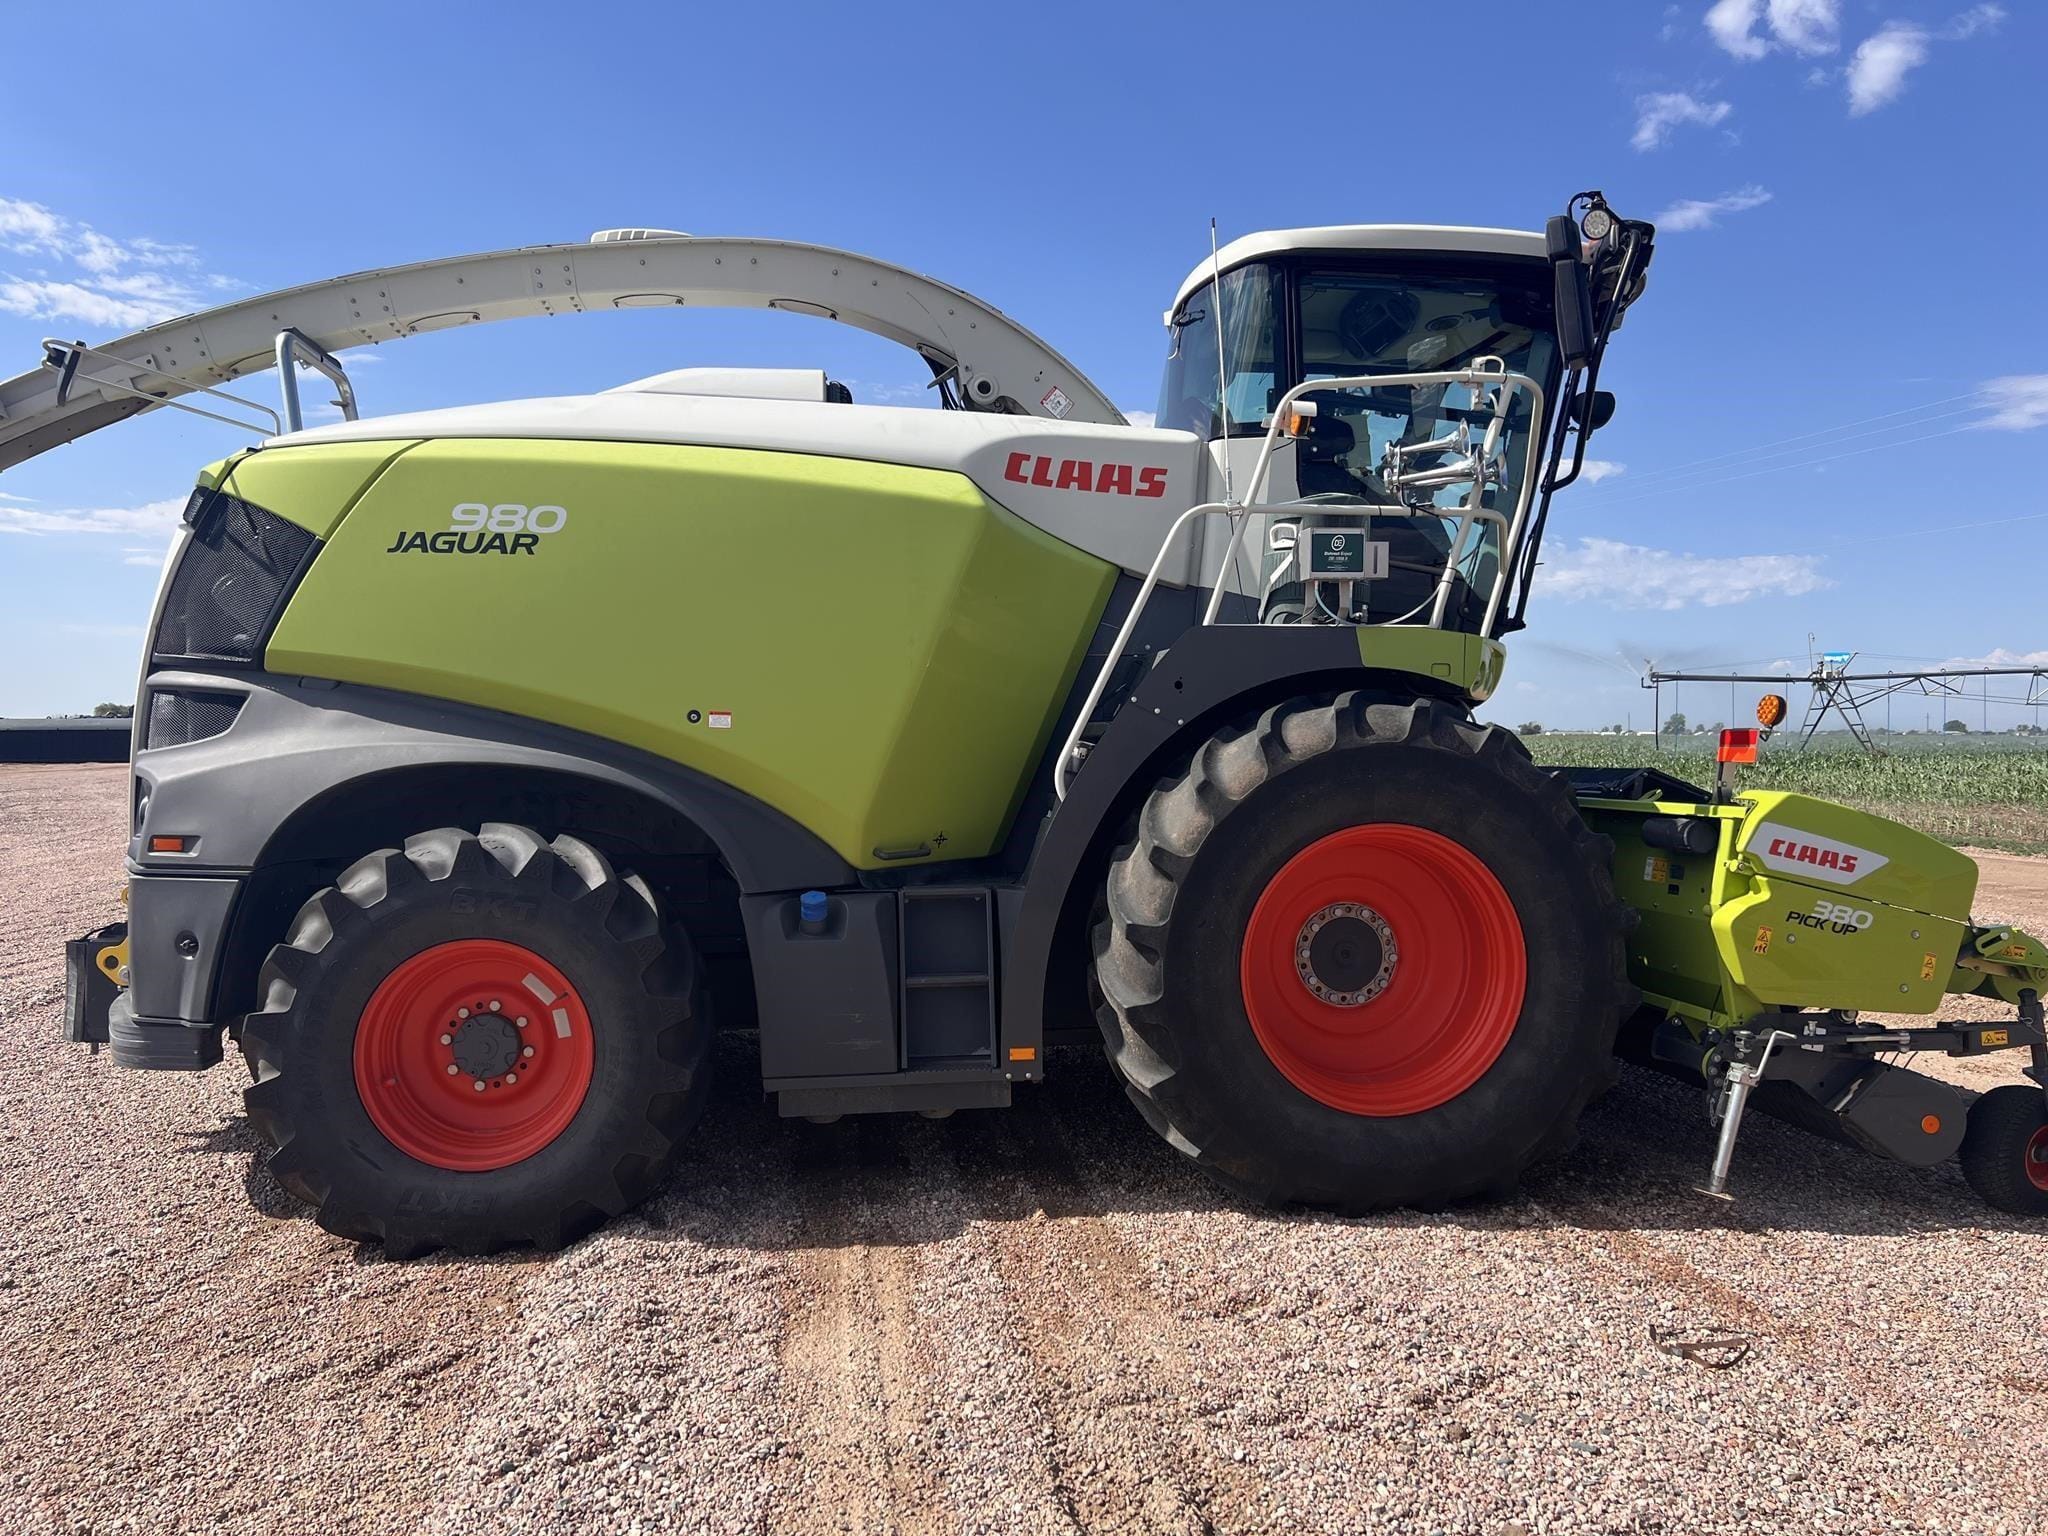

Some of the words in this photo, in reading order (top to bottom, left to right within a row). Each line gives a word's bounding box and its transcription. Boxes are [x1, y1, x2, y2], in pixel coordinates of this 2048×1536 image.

[1004, 452, 1169, 498] CLAAS
[450, 503, 567, 533] 980
[387, 531, 540, 555] JAGUAR
[1768, 838, 1858, 873] CLAAS
[448, 887, 538, 921] BKT
[1811, 900, 1874, 929] 380
[1785, 911, 1829, 931] PICK
[1831, 921, 1858, 936] UP
